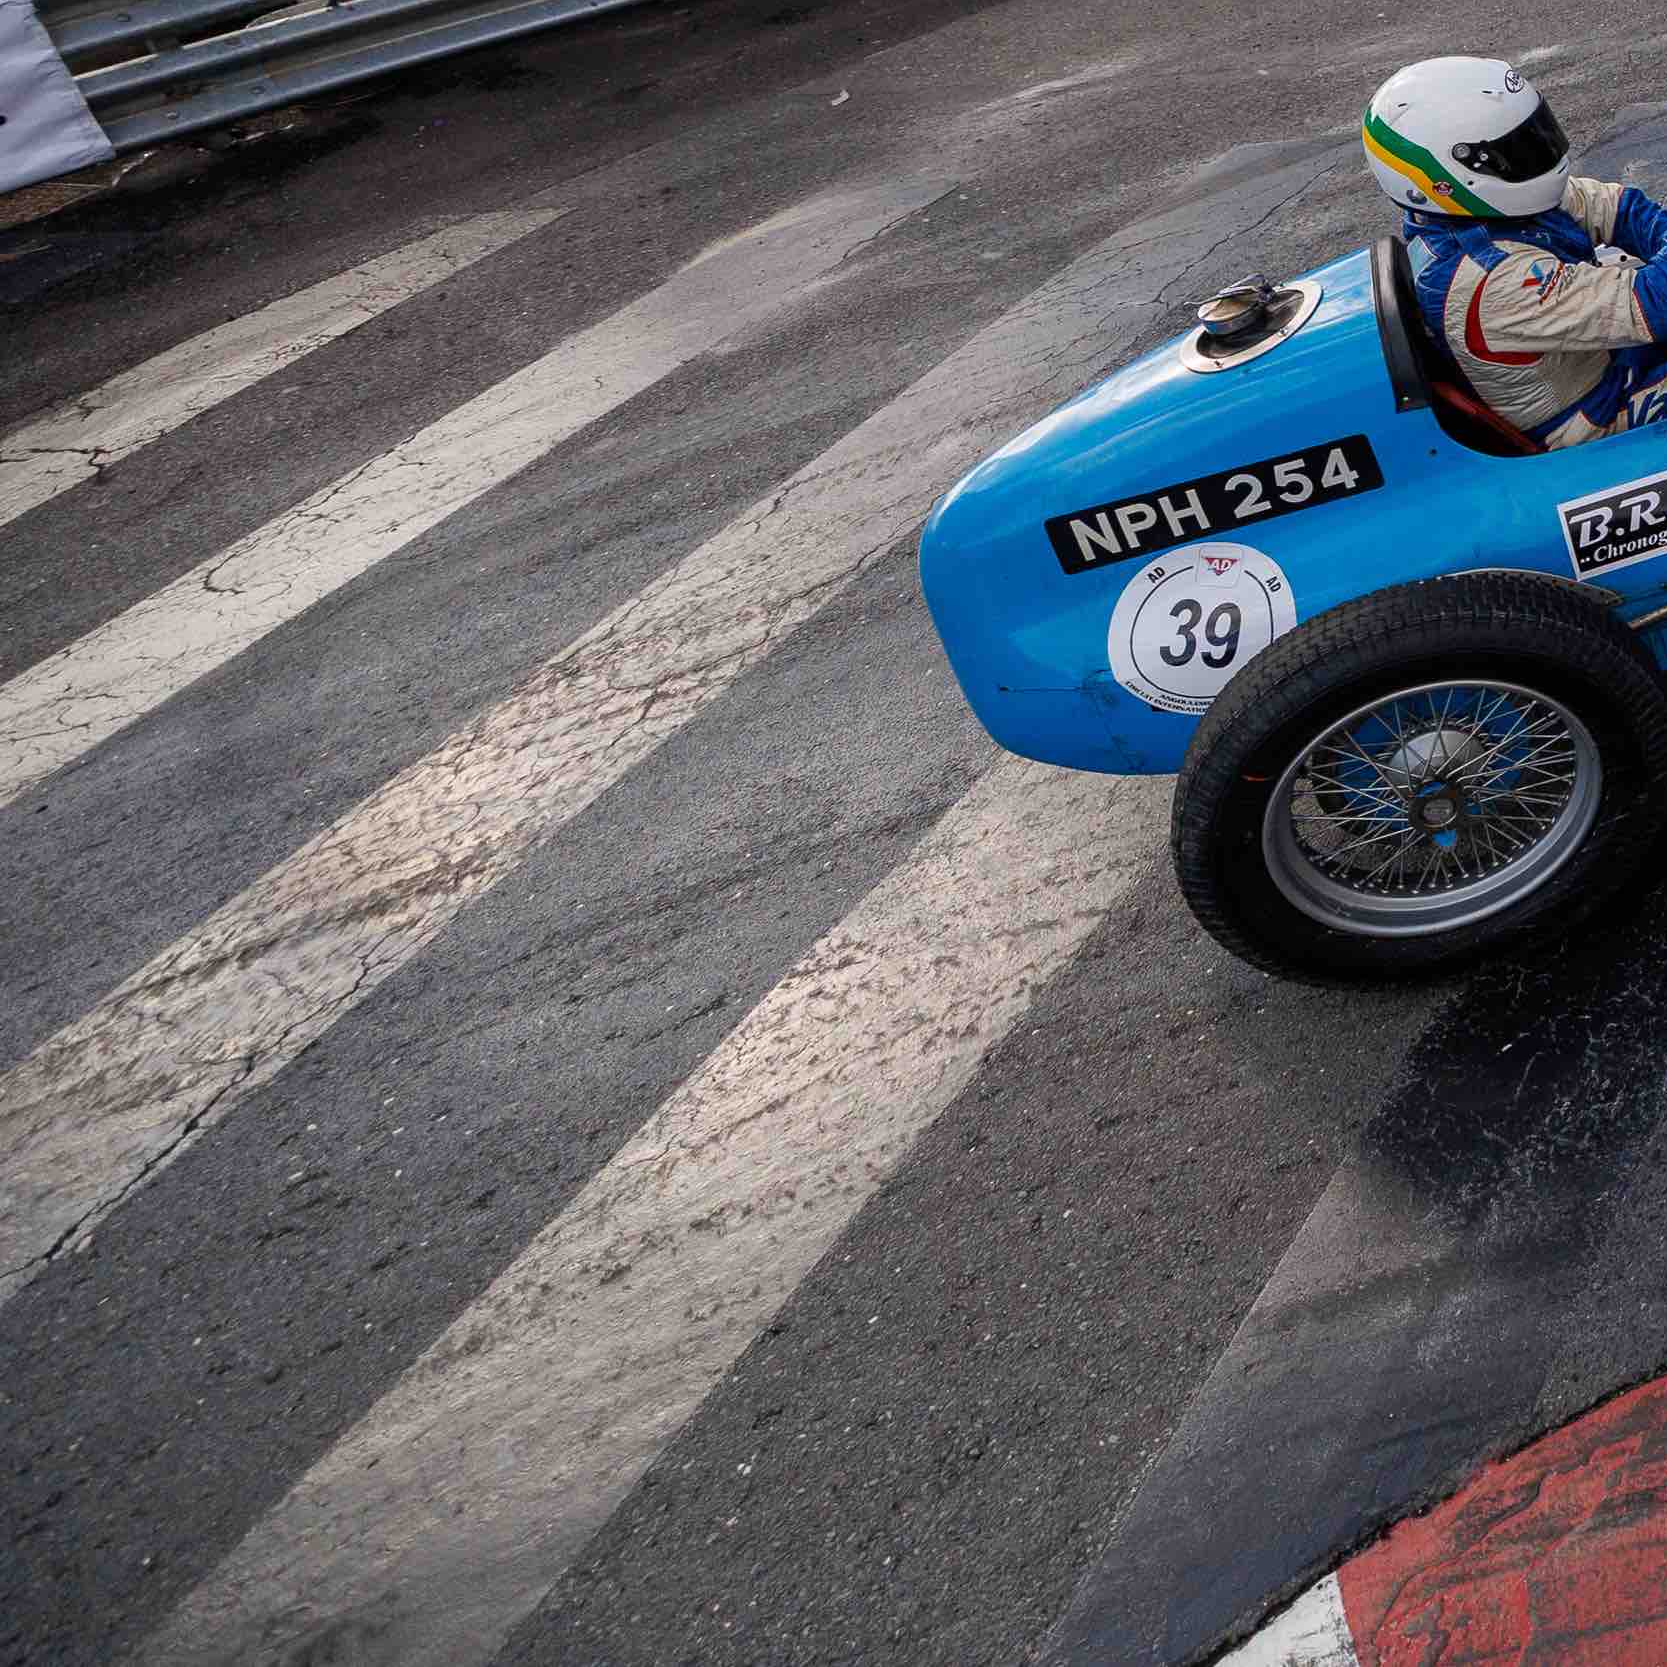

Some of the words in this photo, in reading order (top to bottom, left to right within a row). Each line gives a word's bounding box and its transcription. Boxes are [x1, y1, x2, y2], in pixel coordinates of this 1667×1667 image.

[1069, 488, 1213, 562] NPH
[1223, 447, 1360, 520] 254
[1210, 558, 1233, 571] AD
[1146, 565, 1167, 584] AD
[1265, 575, 1283, 593] AD
[1159, 598, 1242, 669] 39
